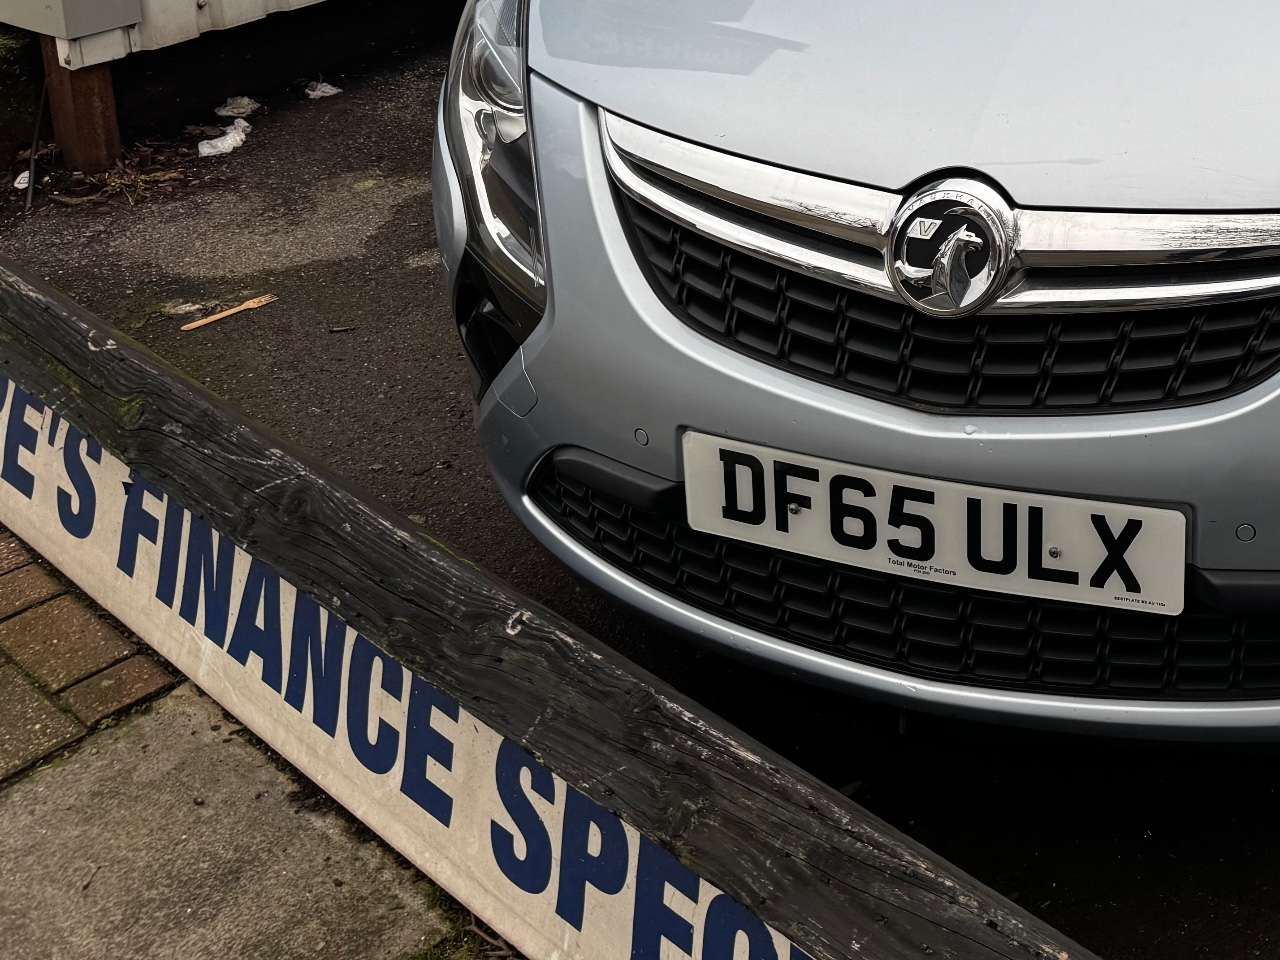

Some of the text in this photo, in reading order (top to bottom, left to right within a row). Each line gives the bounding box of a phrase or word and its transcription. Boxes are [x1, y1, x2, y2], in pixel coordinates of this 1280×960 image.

[718, 447, 1143, 594] DF65 ULX
[888, 557, 905, 567] Total
[907, 561, 928, 571] Motor
[929, 565, 957, 576] Factors
[116, 467, 461, 829] FINANCE
